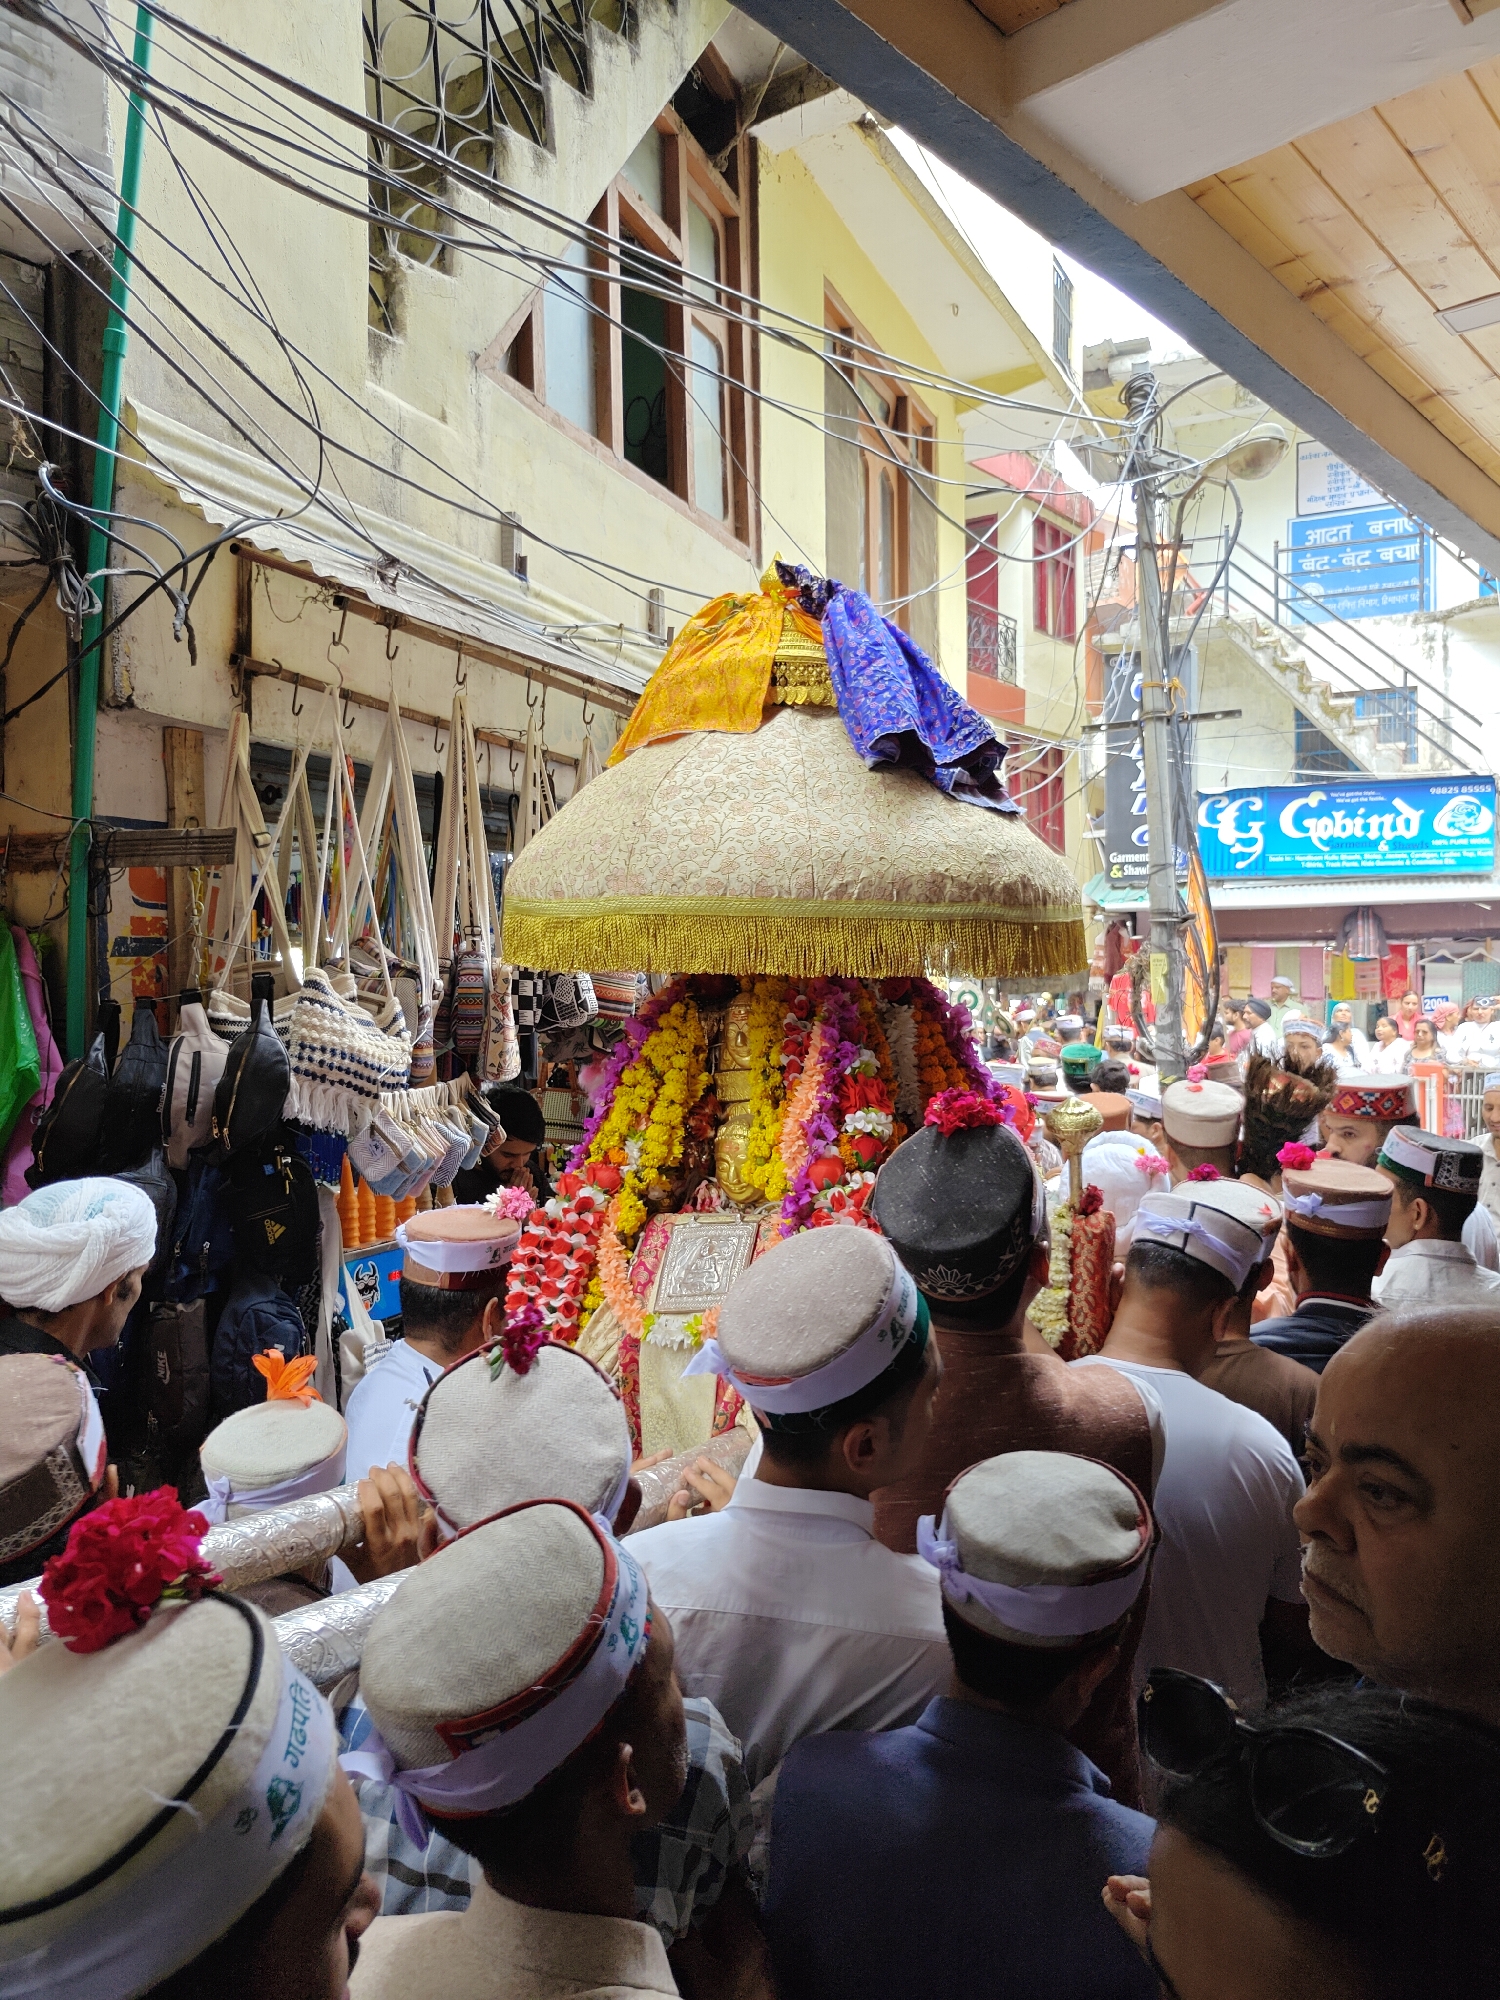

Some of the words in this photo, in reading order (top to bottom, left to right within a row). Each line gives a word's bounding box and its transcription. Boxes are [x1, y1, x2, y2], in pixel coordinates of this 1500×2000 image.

[1429, 786, 1459, 795] 98825
[1279, 791, 1425, 851] Gobind
[1109, 852, 1150, 864] Garment
[1109, 864, 1123, 879] &
[264, 1218, 275, 1245] adidas
